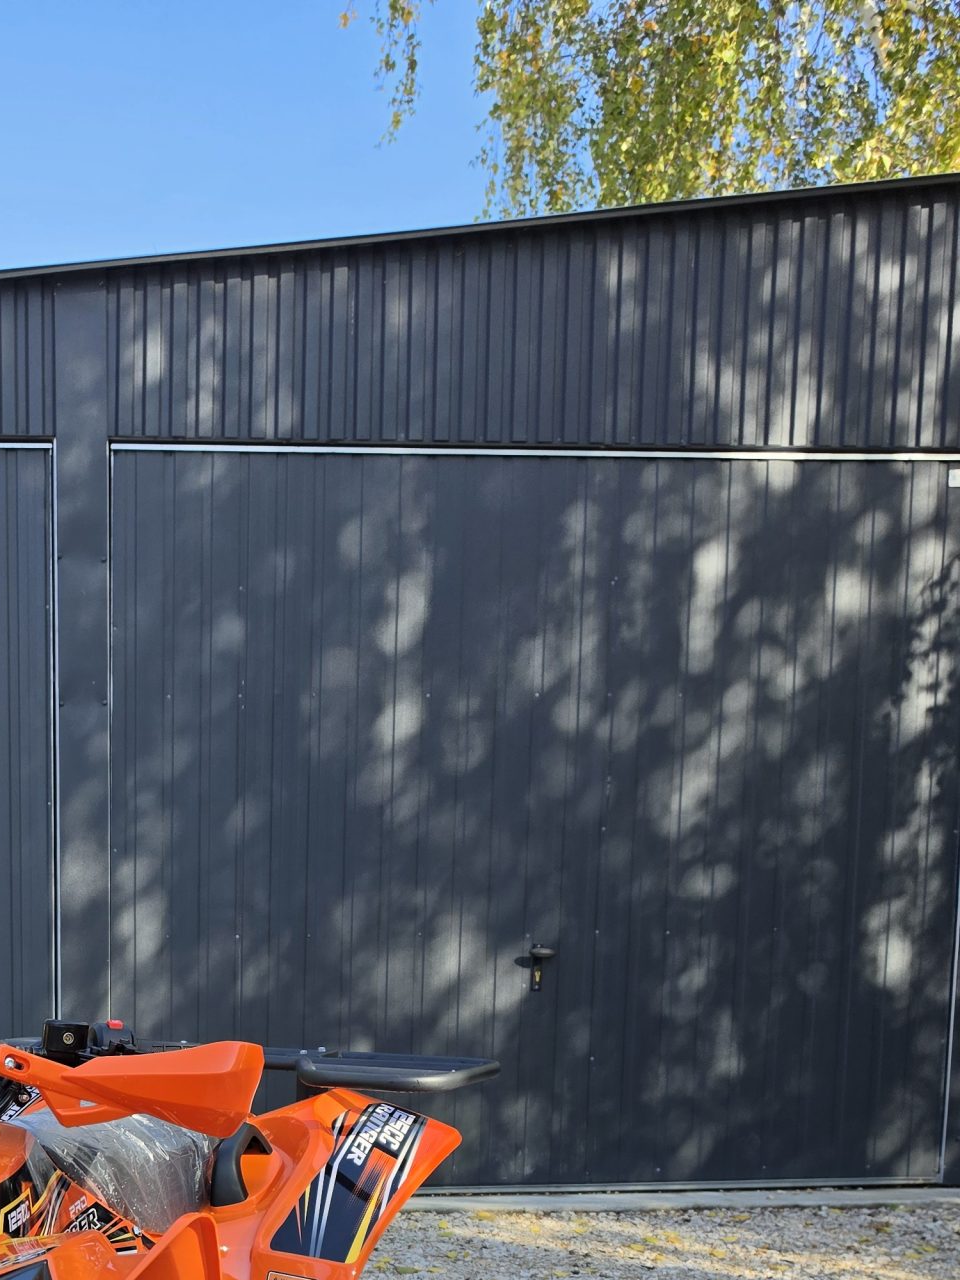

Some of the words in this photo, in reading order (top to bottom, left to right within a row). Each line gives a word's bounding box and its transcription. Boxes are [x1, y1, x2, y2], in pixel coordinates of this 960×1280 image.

[346, 1103, 395, 1166] RANGER
[378, 1109, 416, 1151] 125CC
[69, 1195, 88, 1219] PRO
